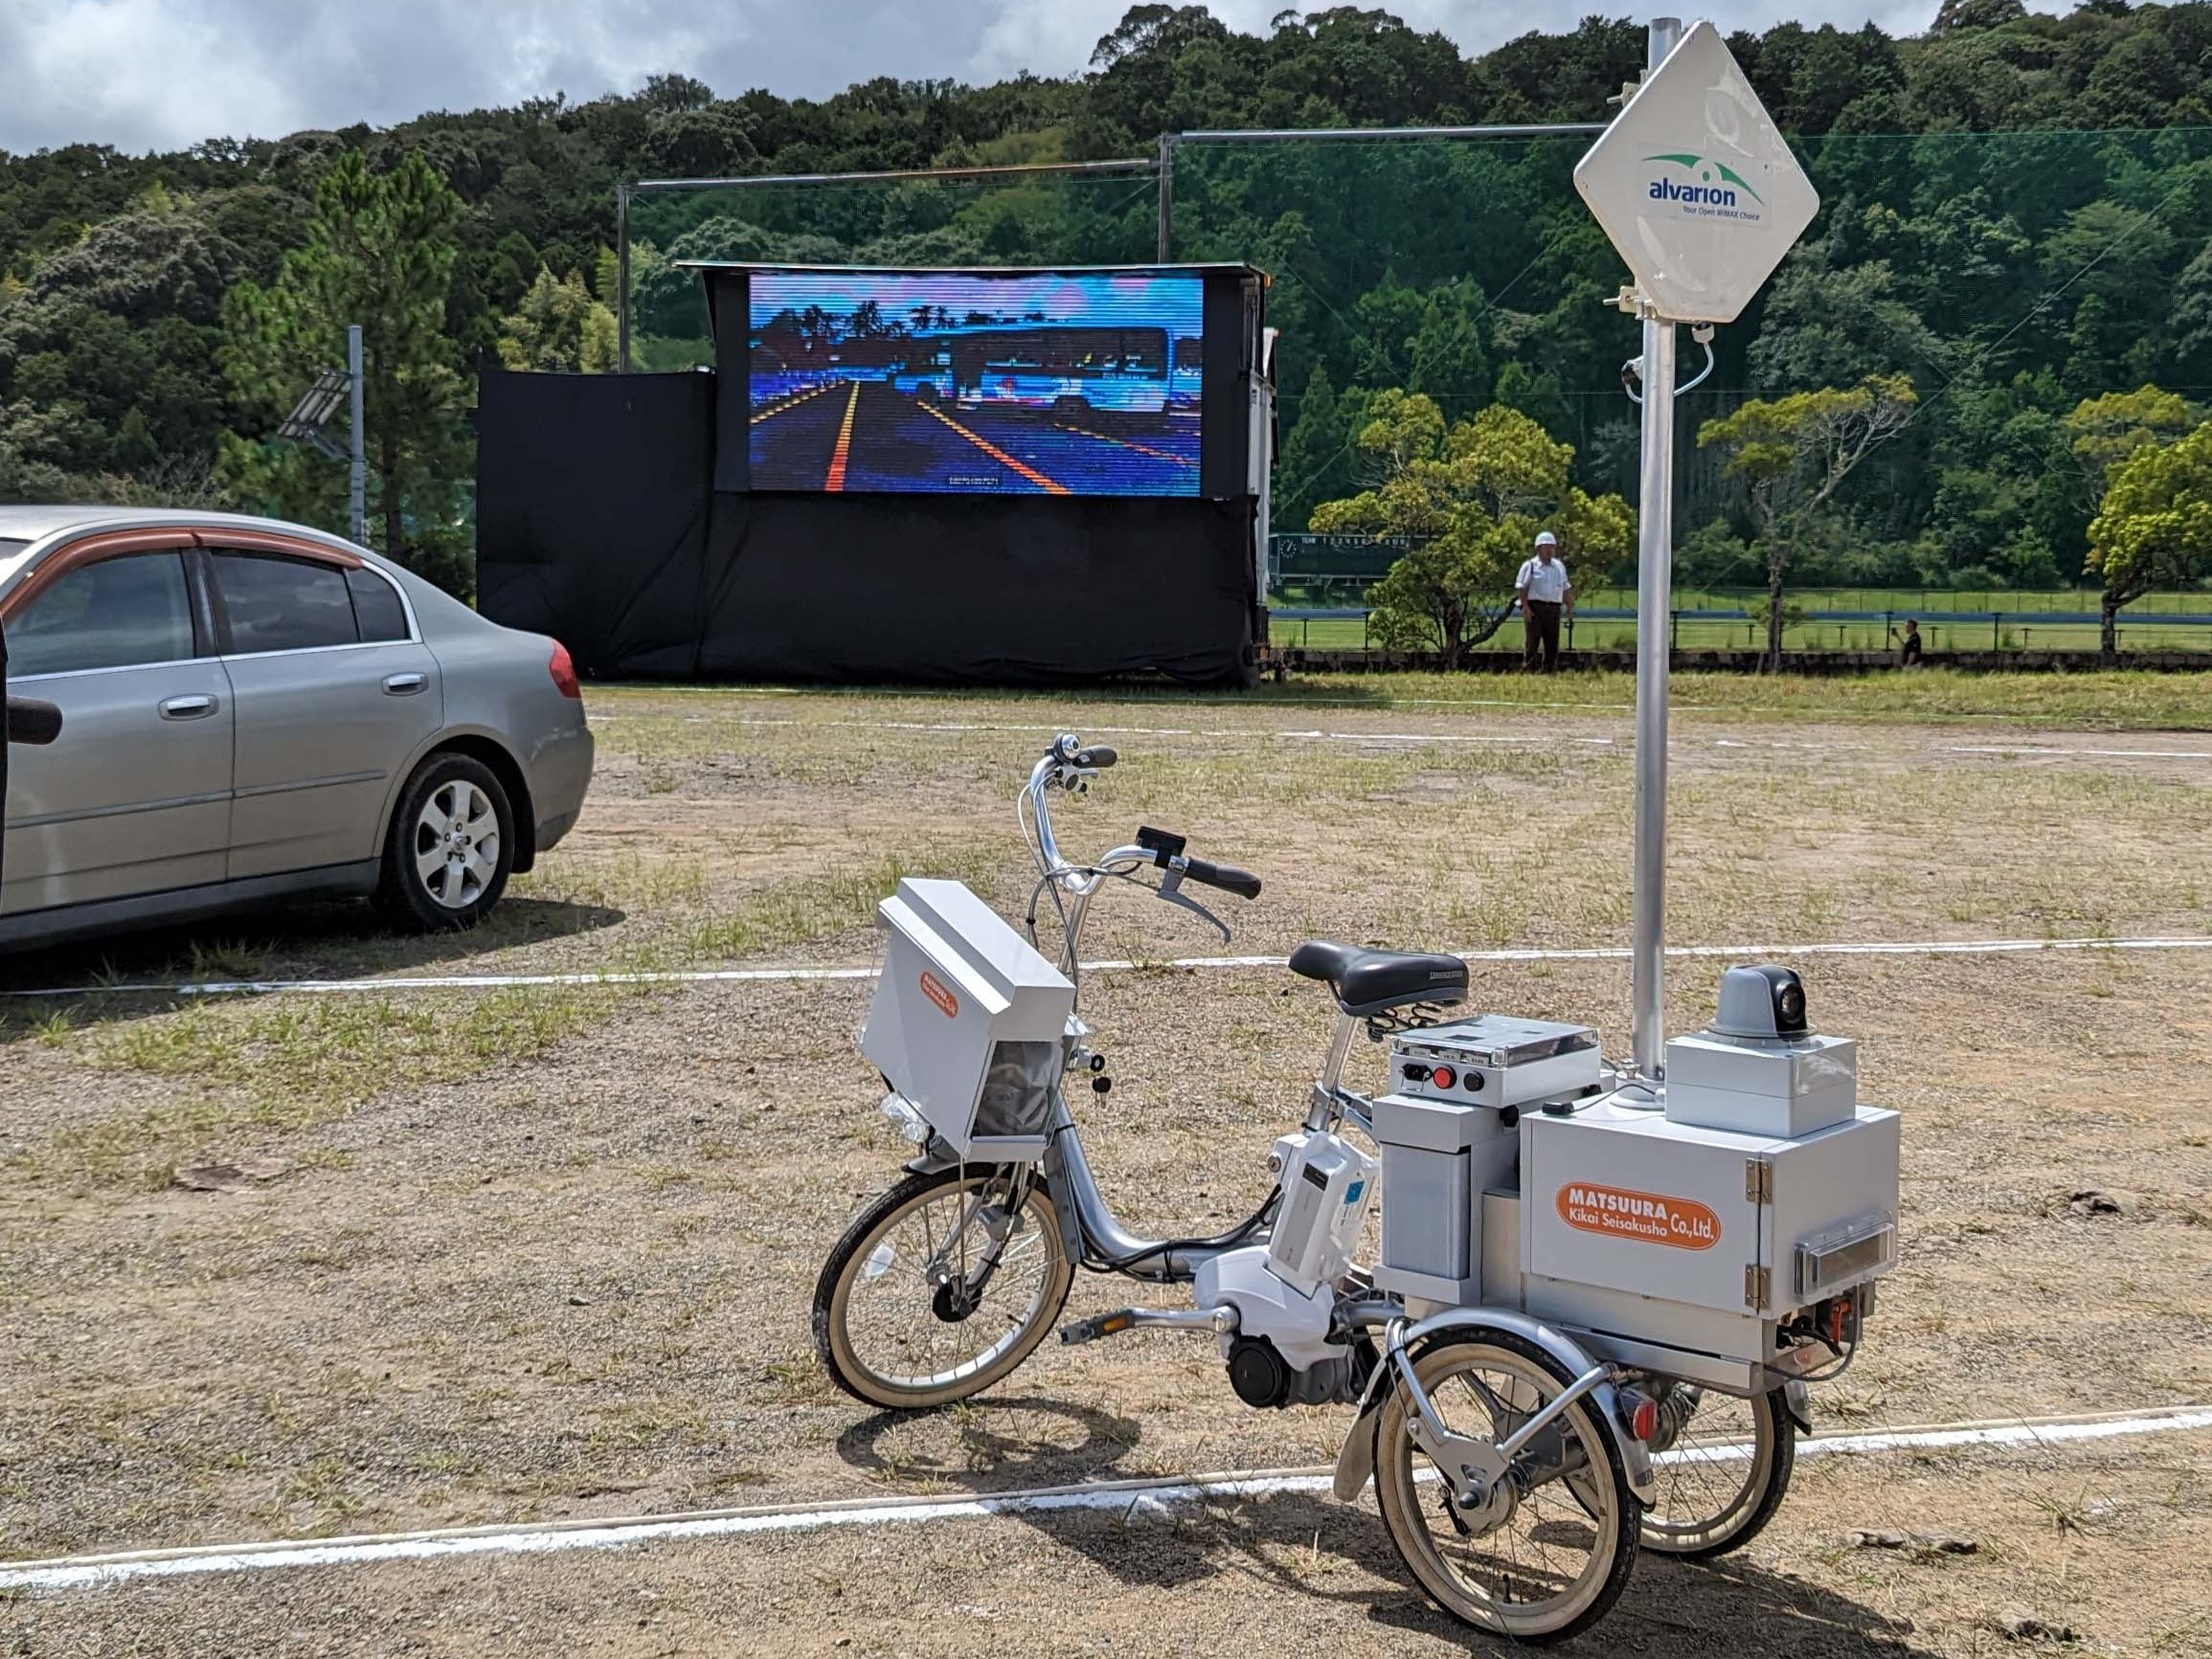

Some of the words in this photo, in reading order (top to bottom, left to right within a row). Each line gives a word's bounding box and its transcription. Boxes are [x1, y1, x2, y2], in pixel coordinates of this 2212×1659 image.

[1649, 177, 1735, 207] alvarion
[1569, 1188, 1668, 1221] MATSUURA
[1569, 1207, 1599, 1225] Kikai
[1602, 1213, 1668, 1237] Seisakusho
